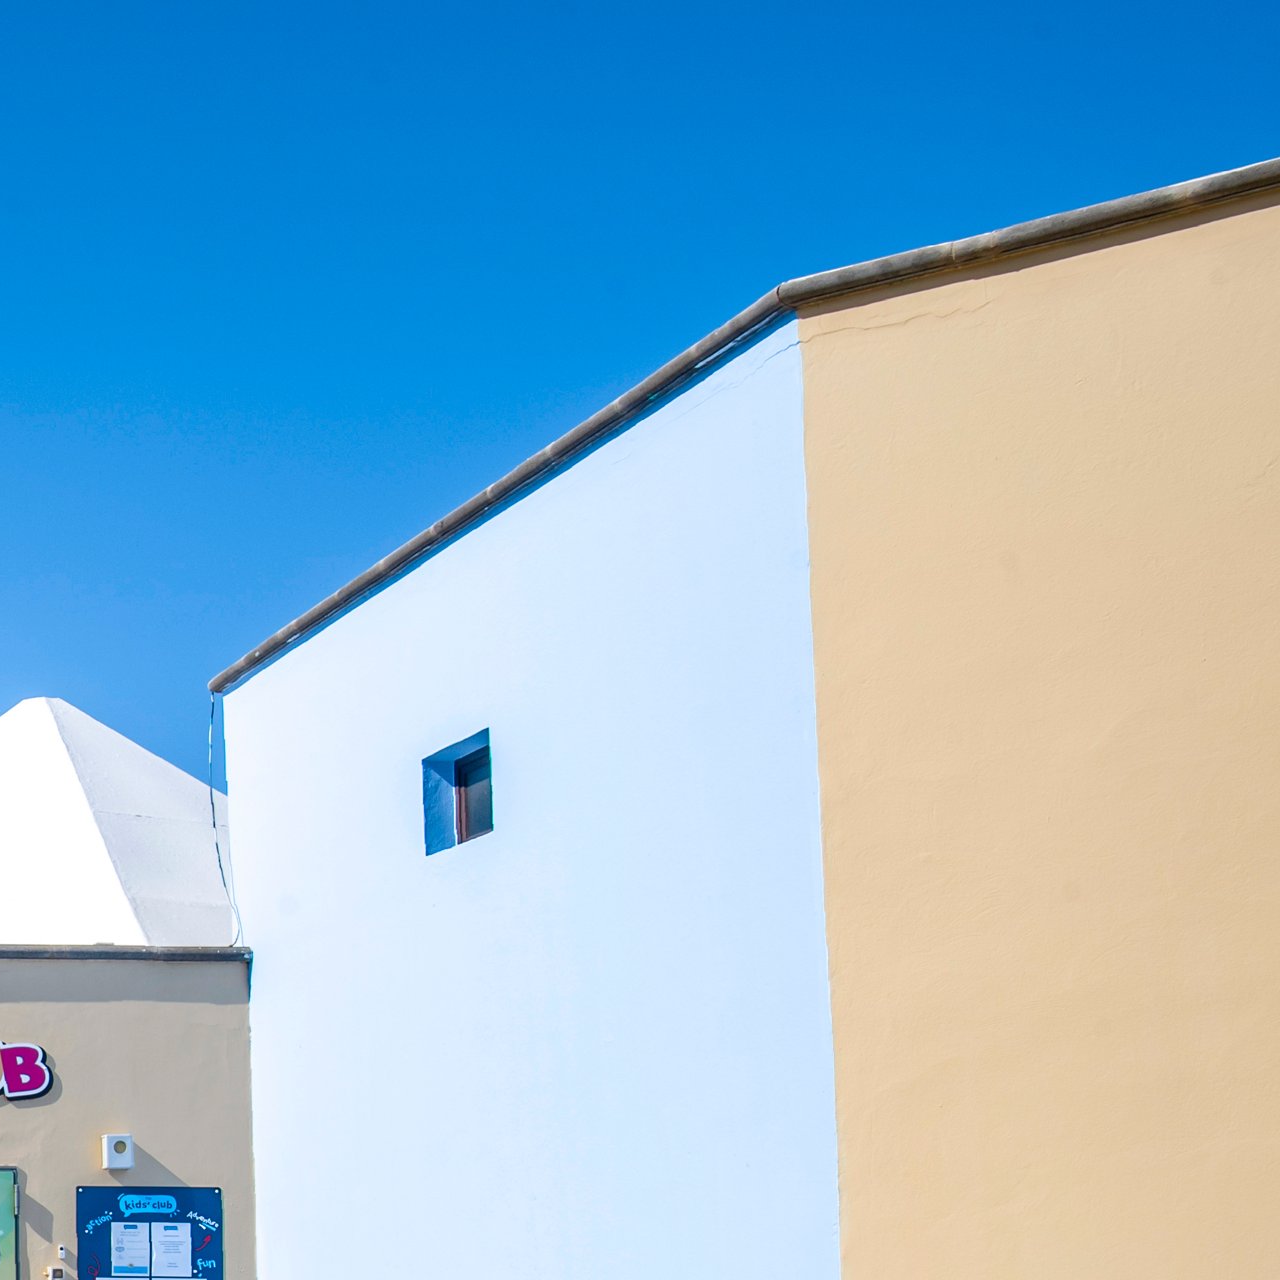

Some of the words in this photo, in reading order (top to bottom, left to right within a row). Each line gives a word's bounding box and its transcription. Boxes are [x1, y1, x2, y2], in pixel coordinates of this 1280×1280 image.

[152, 1200, 173, 1209] club
[86, 1214, 112, 1230] action
[186, 1211, 219, 1228] Adventure
